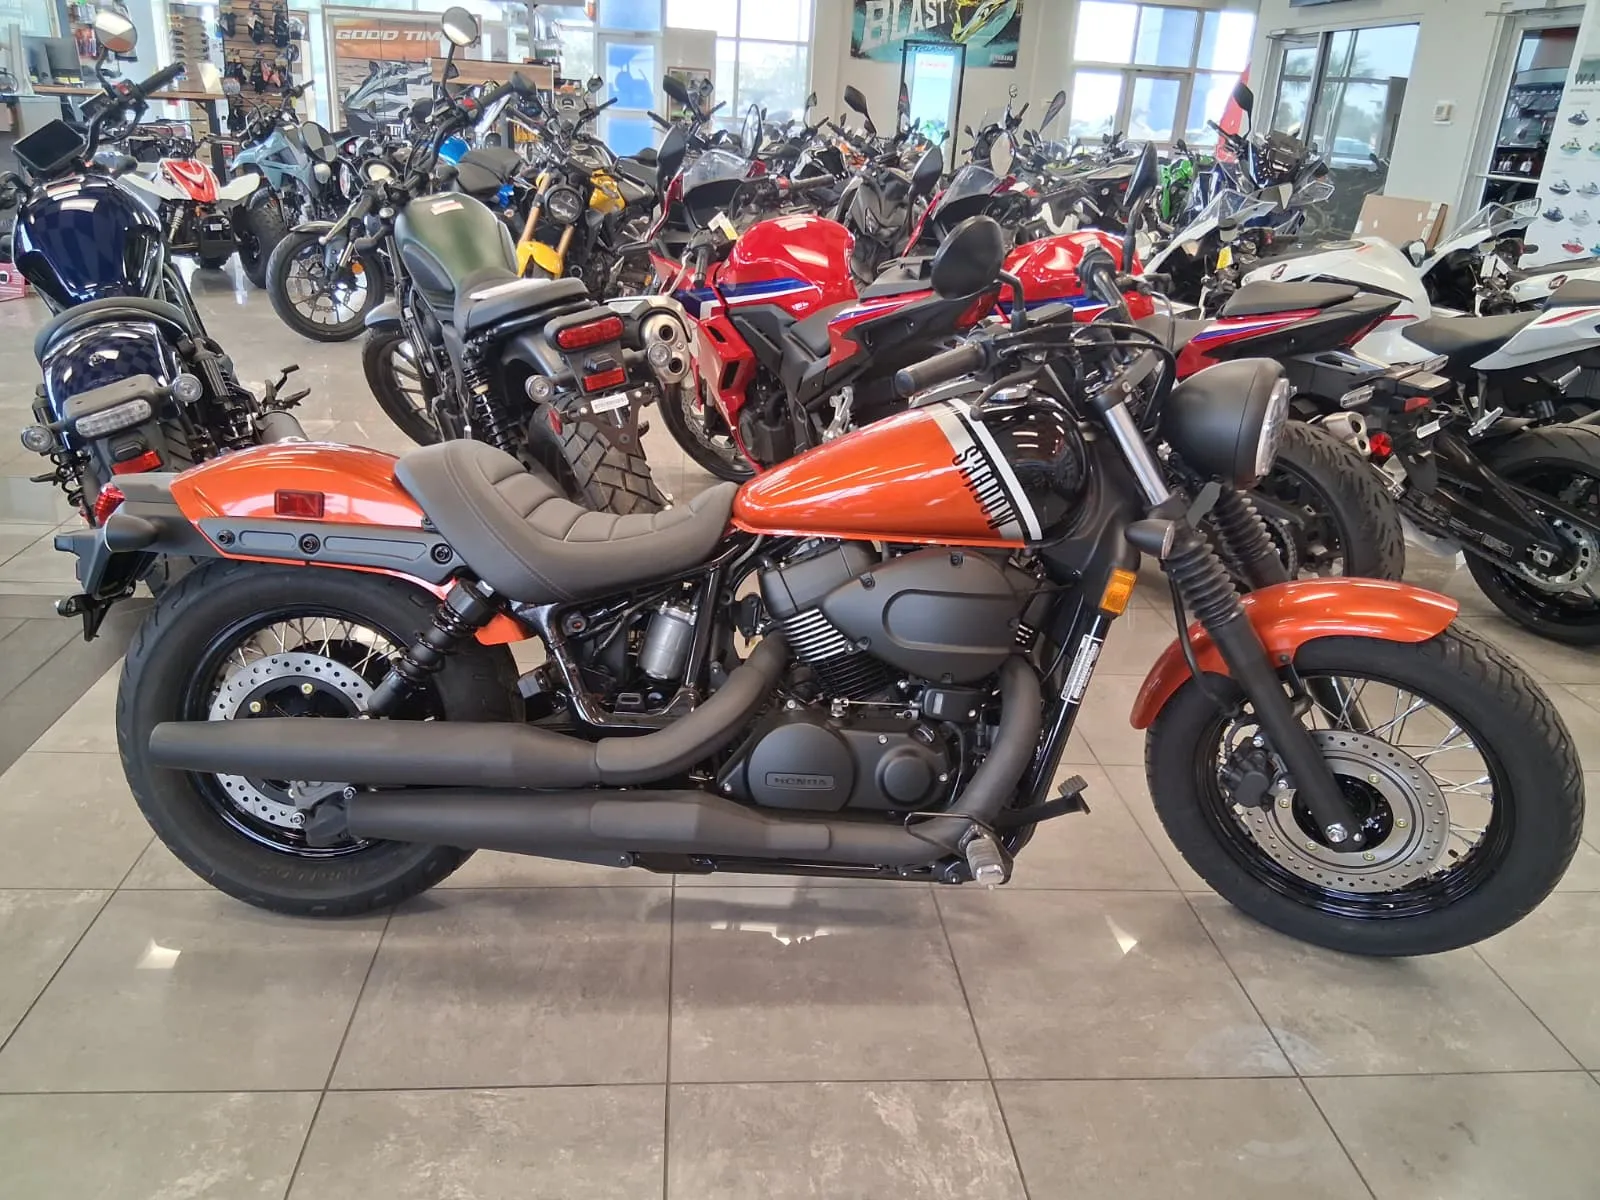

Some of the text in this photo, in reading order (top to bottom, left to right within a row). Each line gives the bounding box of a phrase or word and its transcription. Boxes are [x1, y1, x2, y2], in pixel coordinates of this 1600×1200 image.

[336, 30, 399, 40] GOOD
[859, 0, 948, 53] BLAST
[952, 446, 1017, 530] SHADOW
[774, 776, 828, 786] HONDA
